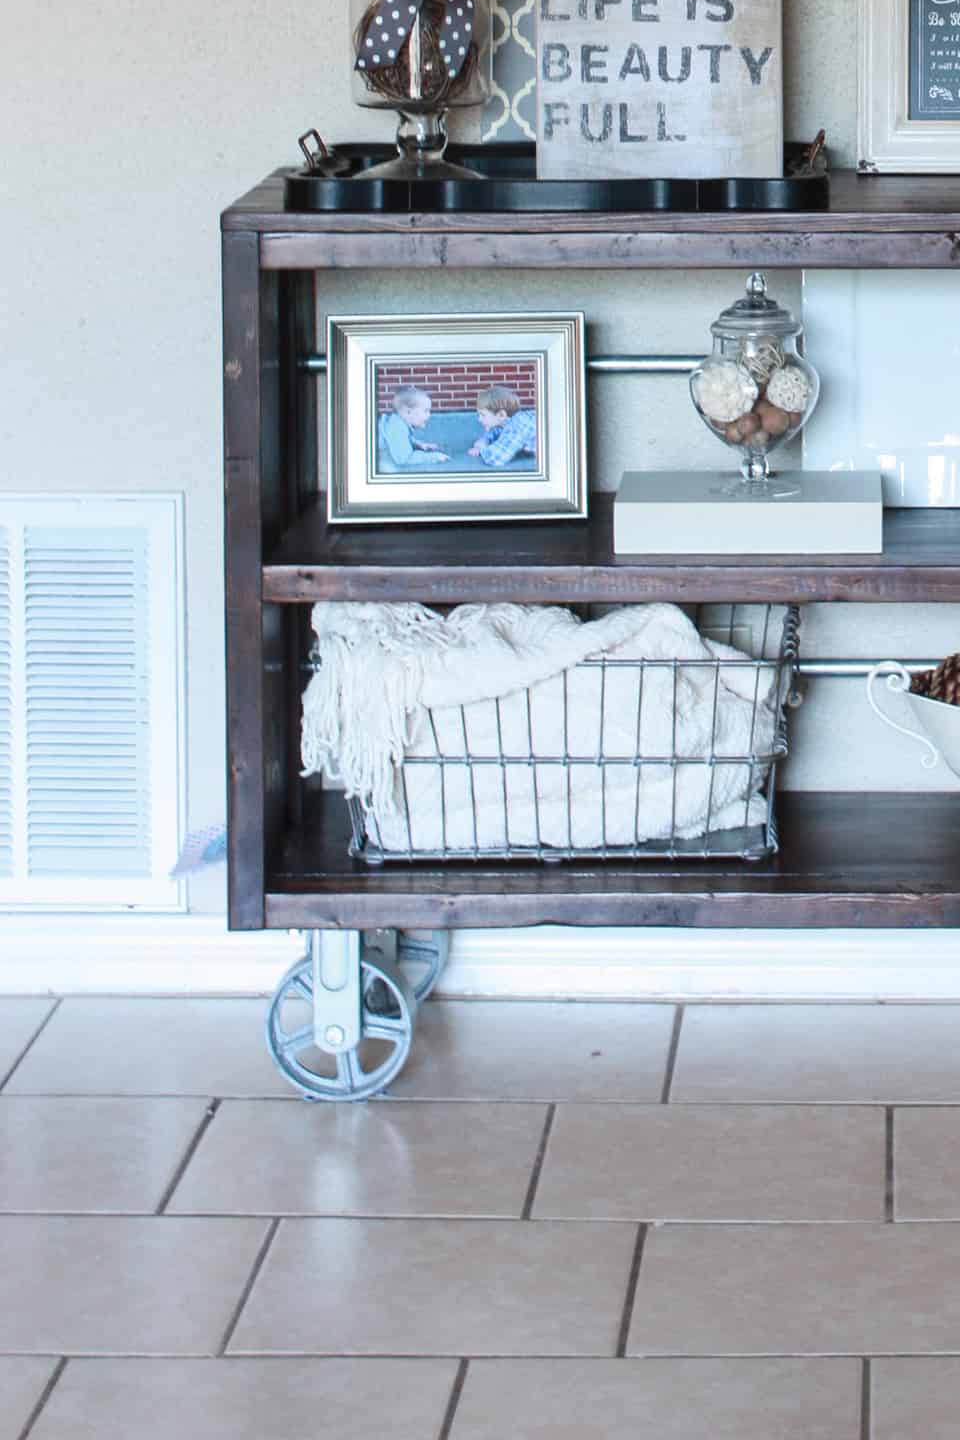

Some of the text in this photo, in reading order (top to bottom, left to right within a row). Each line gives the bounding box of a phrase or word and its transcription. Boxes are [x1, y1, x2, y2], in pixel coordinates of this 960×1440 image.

[928, 12, 944, 26] Be
[542, 43, 773, 84] BEAUTY
[543, 102, 687, 143] FULL
